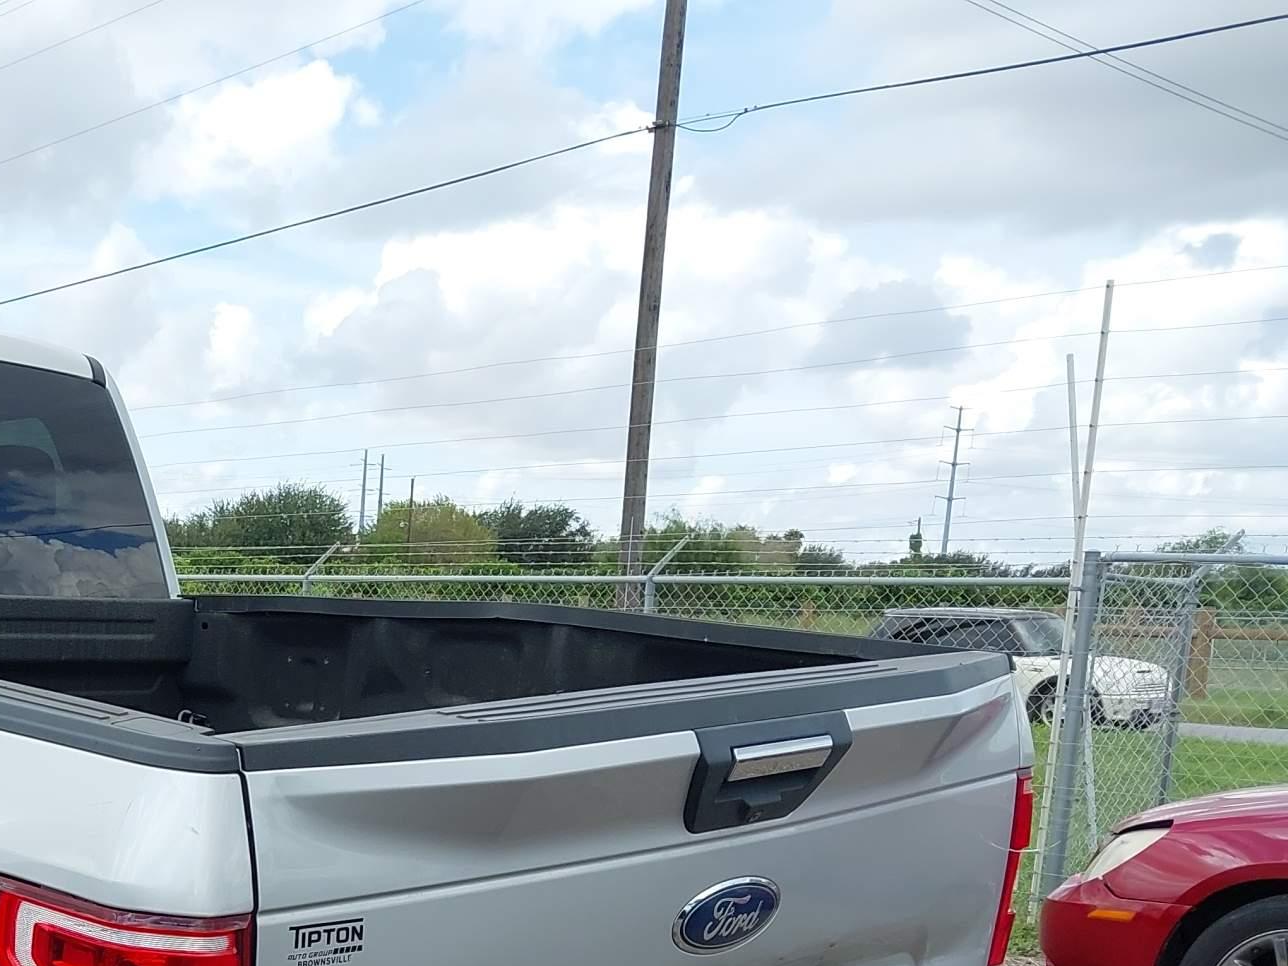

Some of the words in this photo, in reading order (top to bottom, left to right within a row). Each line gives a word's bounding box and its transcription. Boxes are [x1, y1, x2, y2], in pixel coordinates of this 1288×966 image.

[289, 917, 364, 949] TIPTON
[703, 895, 764, 941] Ford
[287, 953, 307, 961] AUTO
[308, 949, 333, 959] GROUP
